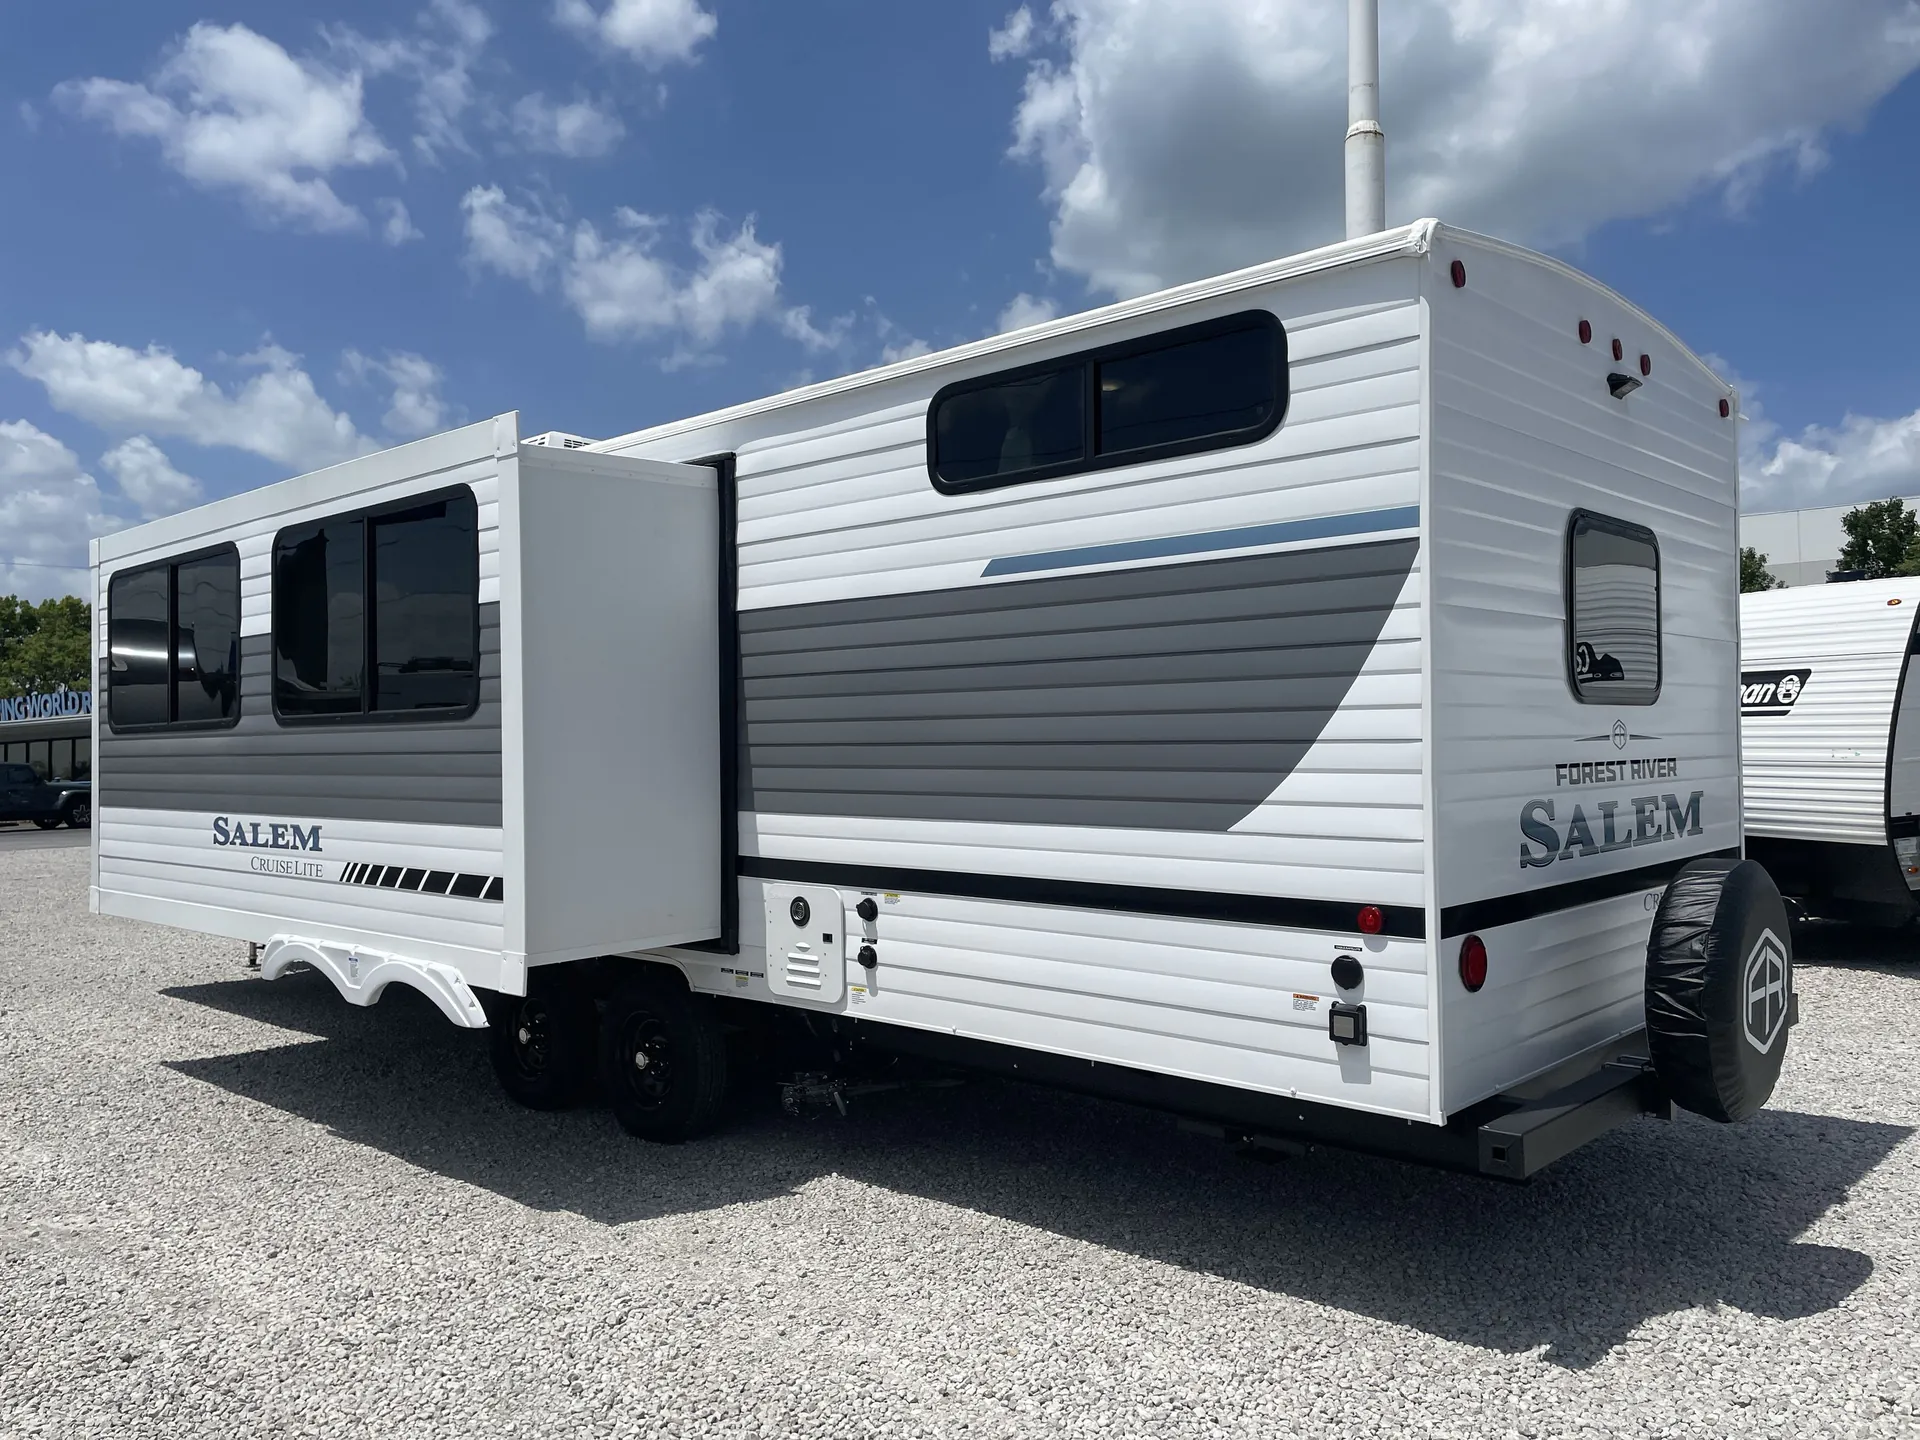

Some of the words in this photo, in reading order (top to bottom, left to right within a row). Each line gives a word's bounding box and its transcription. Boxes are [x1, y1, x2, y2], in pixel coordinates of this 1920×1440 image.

[0, 696, 25, 721] ING
[26, 691, 79, 719] WORLD
[82, 690, 92, 714] R
[1555, 760, 1627, 786] FOREST
[1630, 758, 1677, 780] RIVER
[213, 816, 323, 852] SALEM
[1520, 790, 1704, 868] SALEM
[1643, 891, 1663, 911] CR
